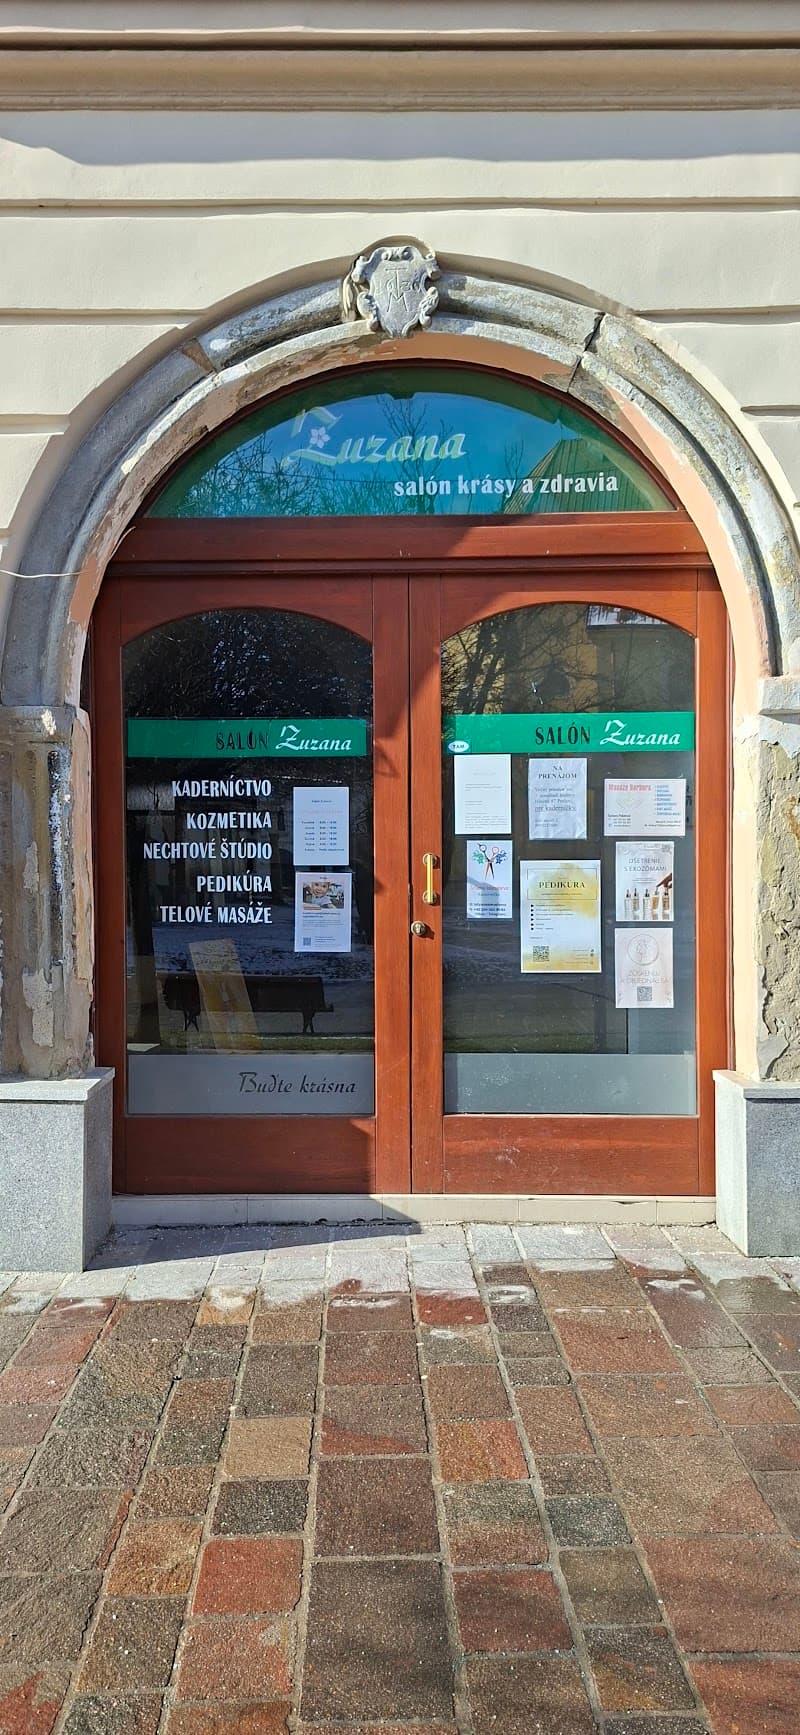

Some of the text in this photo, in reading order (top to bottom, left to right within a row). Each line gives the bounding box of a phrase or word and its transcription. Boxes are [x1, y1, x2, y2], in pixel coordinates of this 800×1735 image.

[283, 405, 466, 468] Zuzana
[394, 471, 619, 500] salón krásy a zdravia
[215, 724, 353, 752] SALÓN Zuzana
[535, 719, 681, 746] SALÓN Zuzana
[172, 775, 272, 798] KADERNÍCTVO
[186, 811, 272, 830] KOZMETIKA
[143, 837, 272, 860] NECHTOVÉ ŠTÚDIO
[196, 869, 272, 893] PEDIKÚRA
[160, 900, 273, 924] TELOVÉ MASÁŽE
[238, 1070, 358, 1096] Buďte krásna
